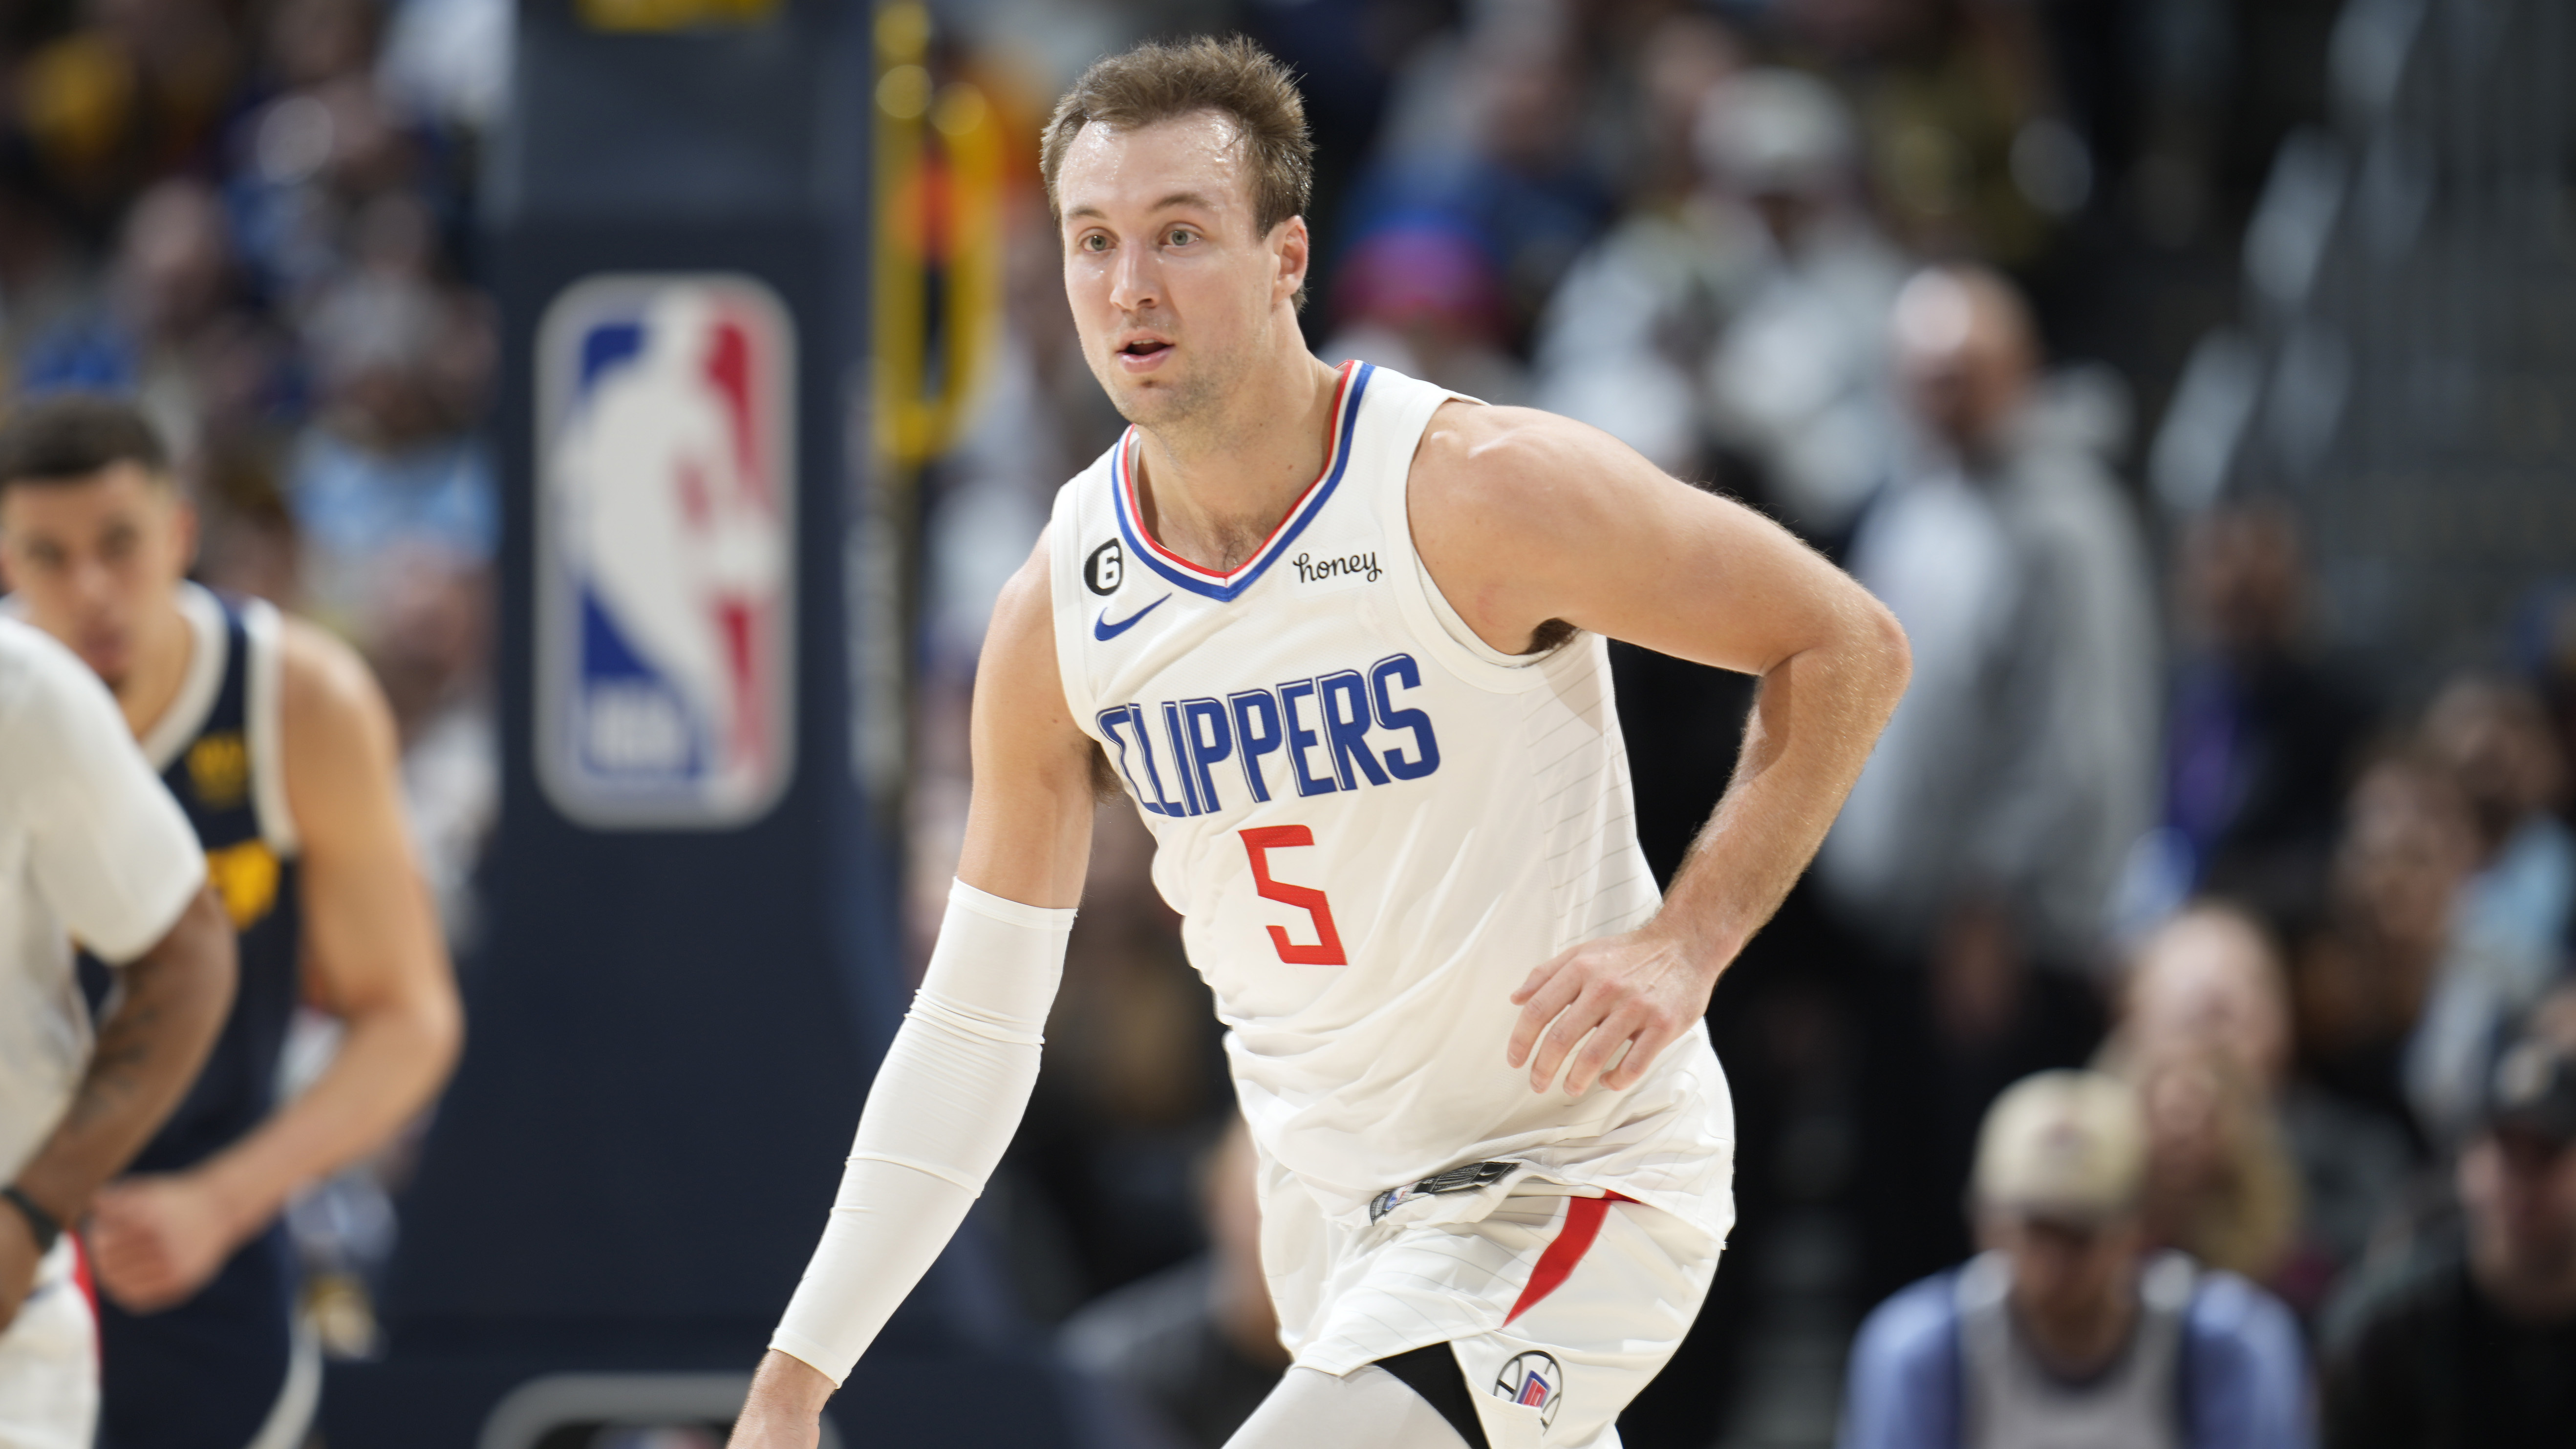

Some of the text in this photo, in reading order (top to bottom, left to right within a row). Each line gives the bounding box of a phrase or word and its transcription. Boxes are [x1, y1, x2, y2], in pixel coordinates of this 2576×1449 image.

[1096, 545, 1120, 590] 6
[1293, 552, 1382, 583] honey
[1096, 653, 1440, 817] CLIPPERS
[1238, 824, 1348, 966] 5
